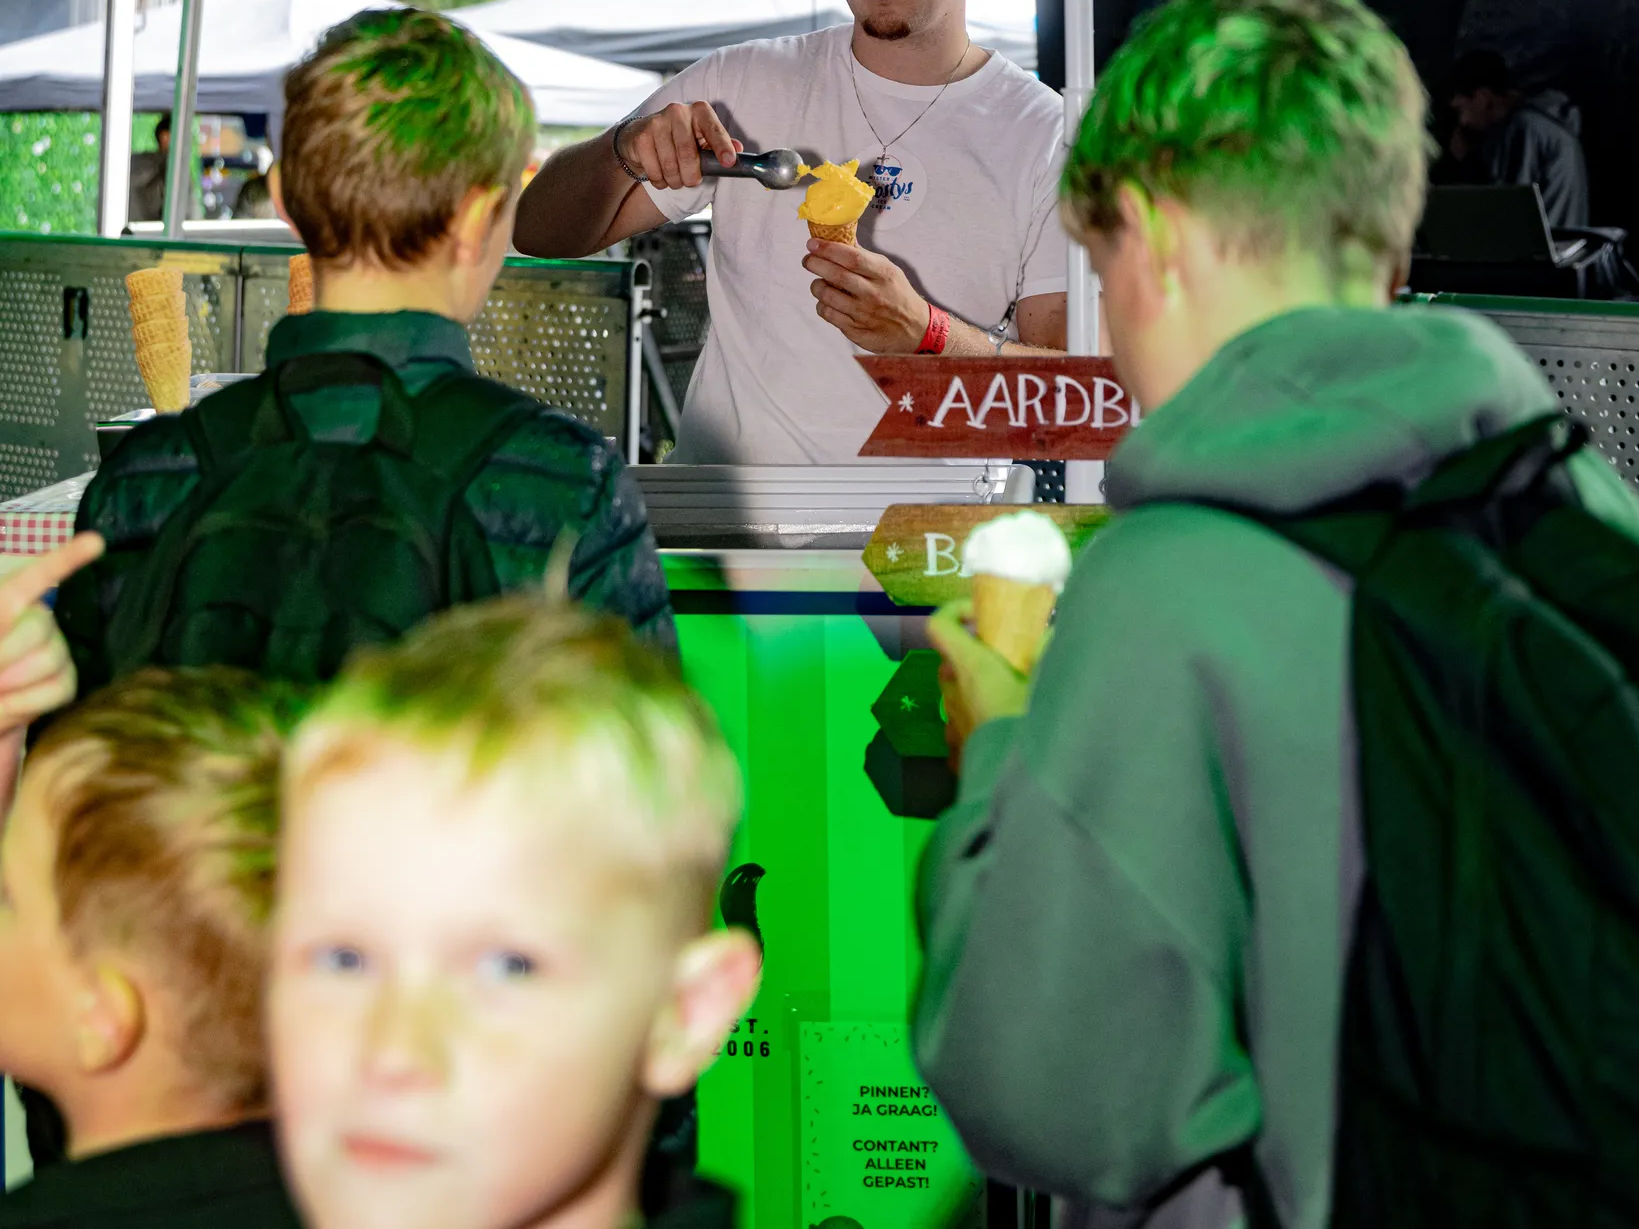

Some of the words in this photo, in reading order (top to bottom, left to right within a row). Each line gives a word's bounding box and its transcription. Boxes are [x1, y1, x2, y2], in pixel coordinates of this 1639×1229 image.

[866, 176, 914, 200] ostys
[859, 1085, 930, 1098] PINNEN?
[852, 1103, 872, 1115] JA
[876, 1104, 937, 1116] GRAAG!
[852, 1139, 938, 1152] CONTANT?
[865, 1158, 926, 1170] ALLEEN
[863, 1175, 930, 1188] GEPAST!
